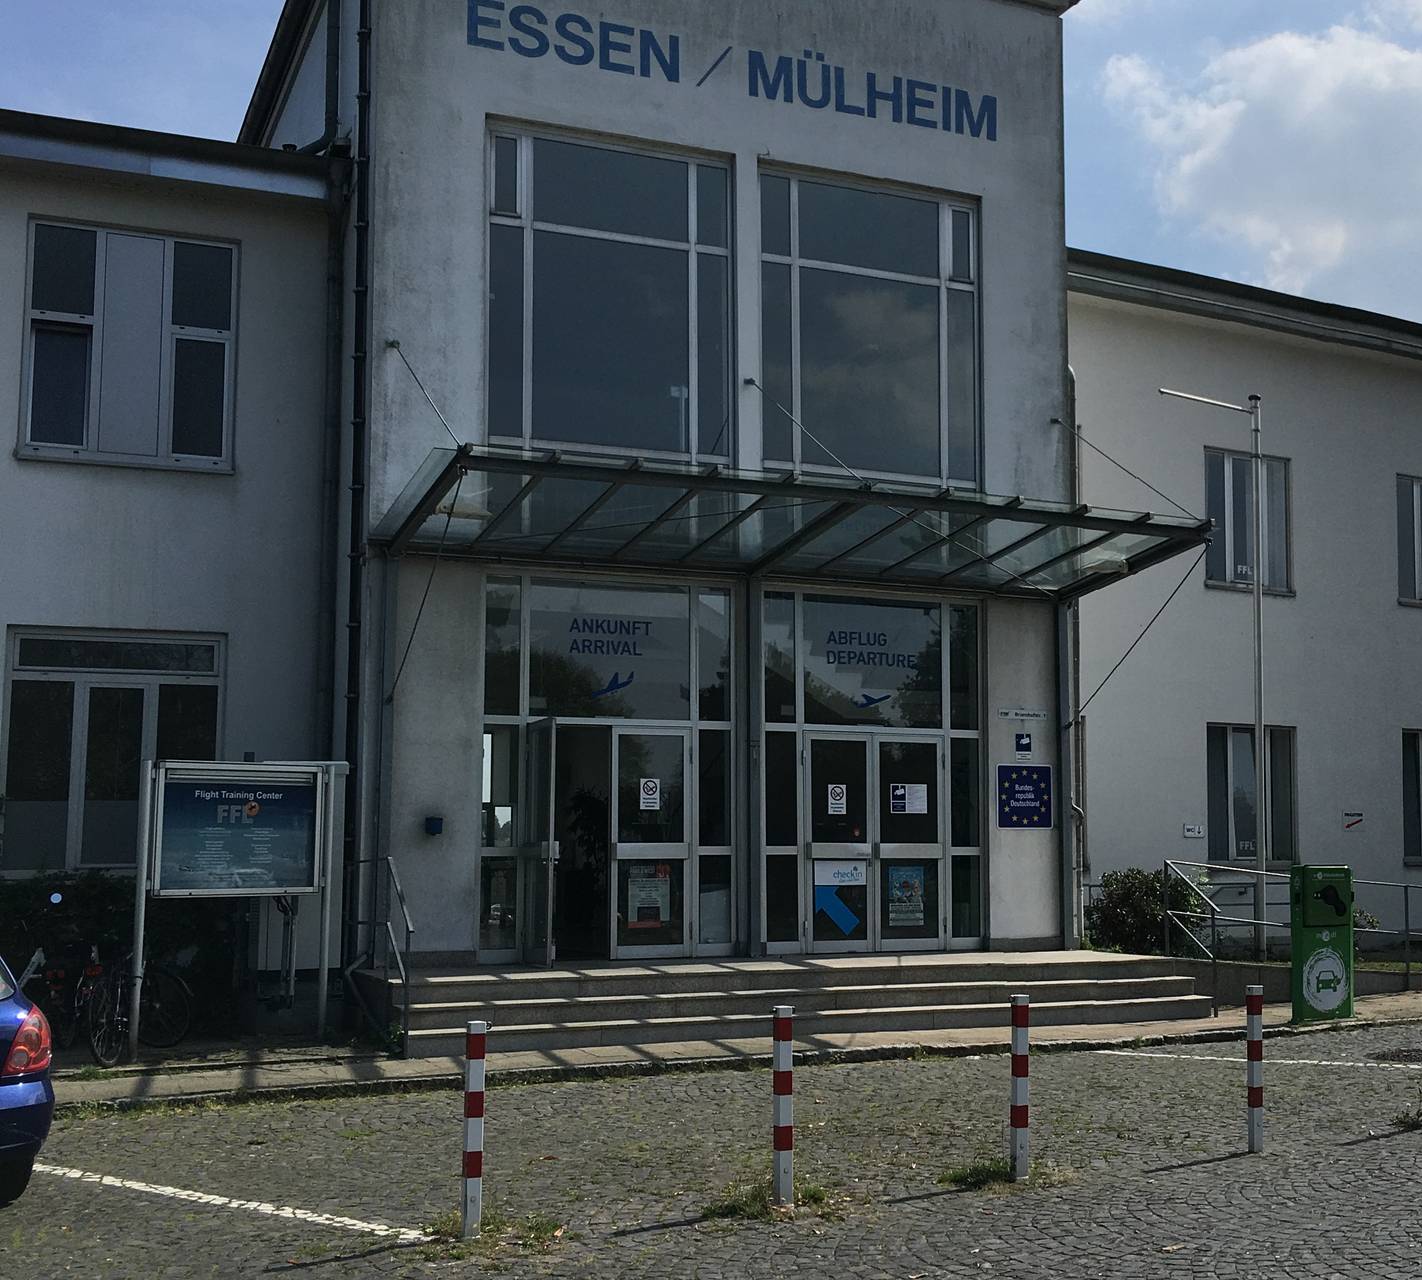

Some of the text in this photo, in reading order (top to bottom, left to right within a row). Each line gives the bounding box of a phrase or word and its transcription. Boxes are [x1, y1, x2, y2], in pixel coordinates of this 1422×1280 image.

[466, 0, 680, 84] ESSEN
[747, 49, 998, 142] MÜLHEIM
[569, 618, 653, 636] ANKUNFT
[569, 638, 643, 656] ARRIVAL
[826, 630, 887, 647] ABFLUG
[826, 650, 918, 670] DEPARTURE
[194, 790, 284, 800] Flight Training Center
